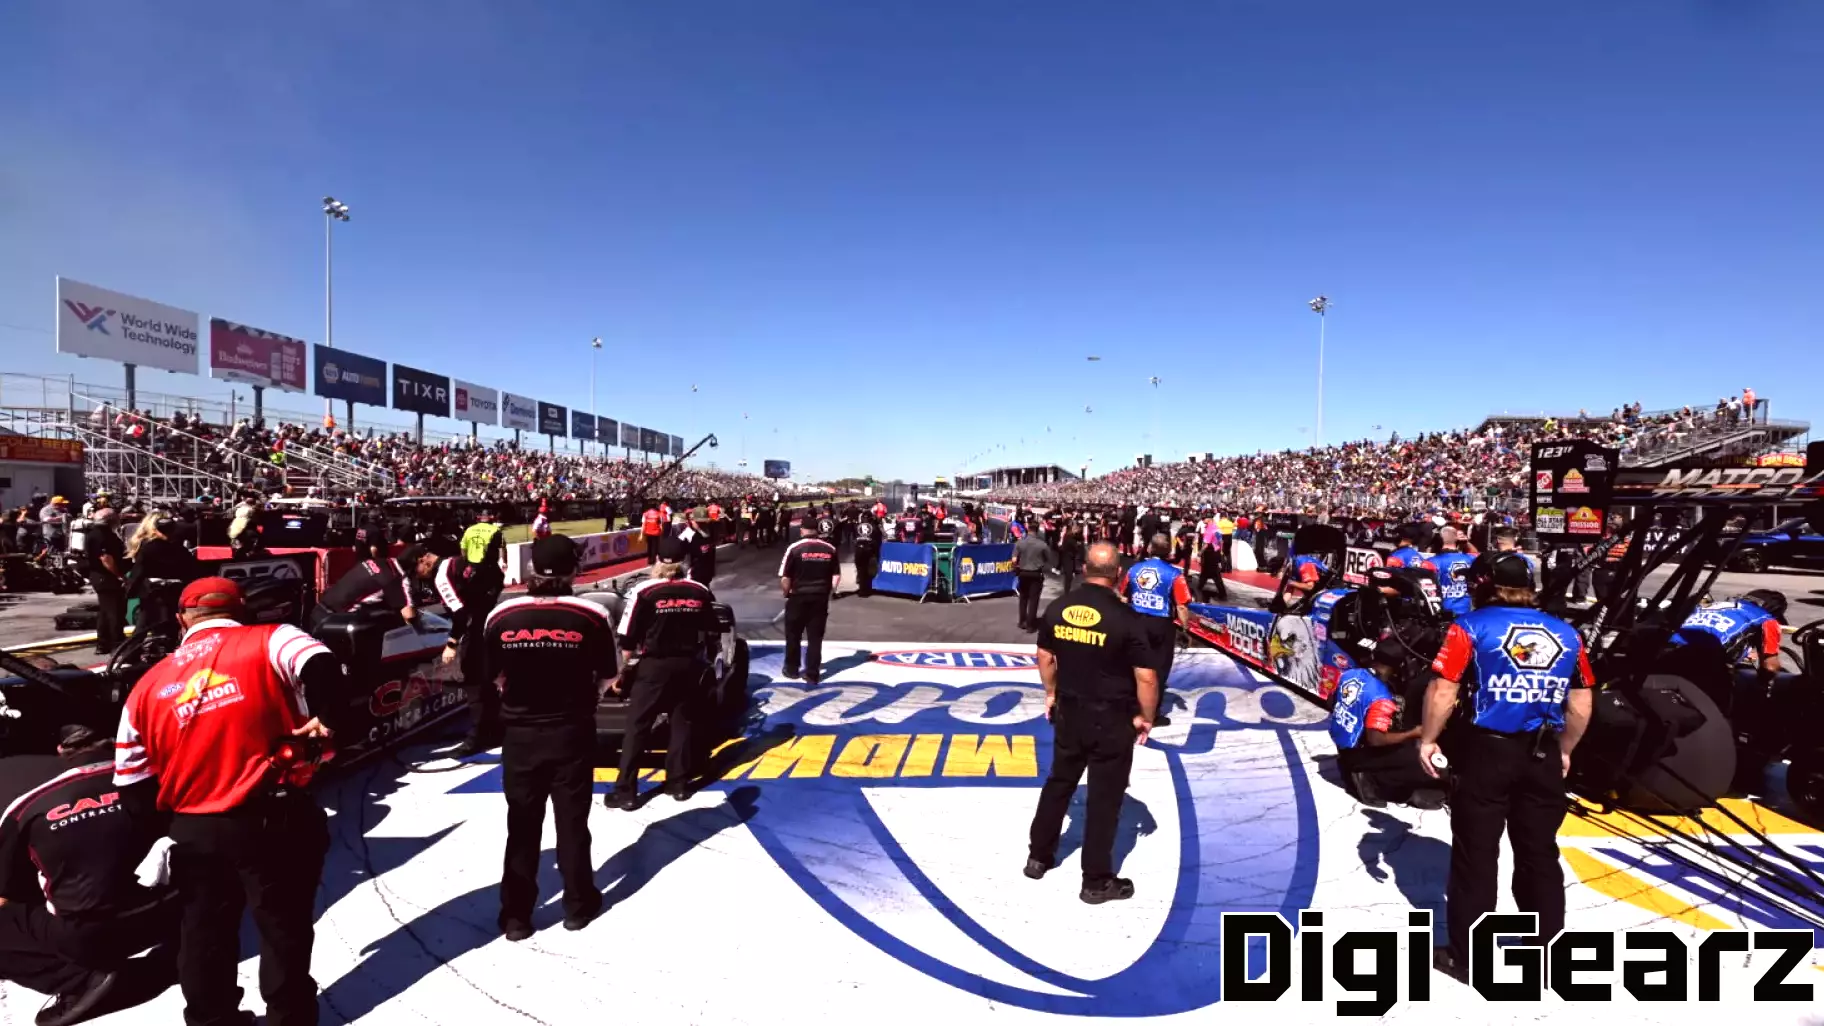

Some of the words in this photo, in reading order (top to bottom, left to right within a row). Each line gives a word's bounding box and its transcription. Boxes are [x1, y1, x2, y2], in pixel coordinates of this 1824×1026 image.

[121, 312, 161, 333] World
[164, 322, 197, 340] Wide
[122, 326, 196, 355] Technology
[341, 369, 359, 383] AUTO
[398, 379, 446, 404] TIXR
[470, 396, 497, 412] TOYOTA
[42, 438, 81, 450] BEER
[1658, 468, 1804, 489] MATCO
[882, 561, 902, 575] AUTO
[903, 563, 928, 577] PARTS
[976, 562, 995, 574] AUTO
[656, 598, 702, 609] CAPCO
[1068, 609, 1095, 623] NHRA
[1226, 612, 1265, 641] MATCO
[501, 628, 583, 643] CAPCO
[1054, 624, 1107, 647] SECURITY
[502, 641, 562, 650] CONTRACTORS
[895, 651, 1034, 668] NHRA
[1488, 674, 1569, 689] MATCO
[1488, 687, 1566, 704] TOOLS
[46, 791, 120, 821] CAP
[50, 804, 122, 831] CONTRACT
